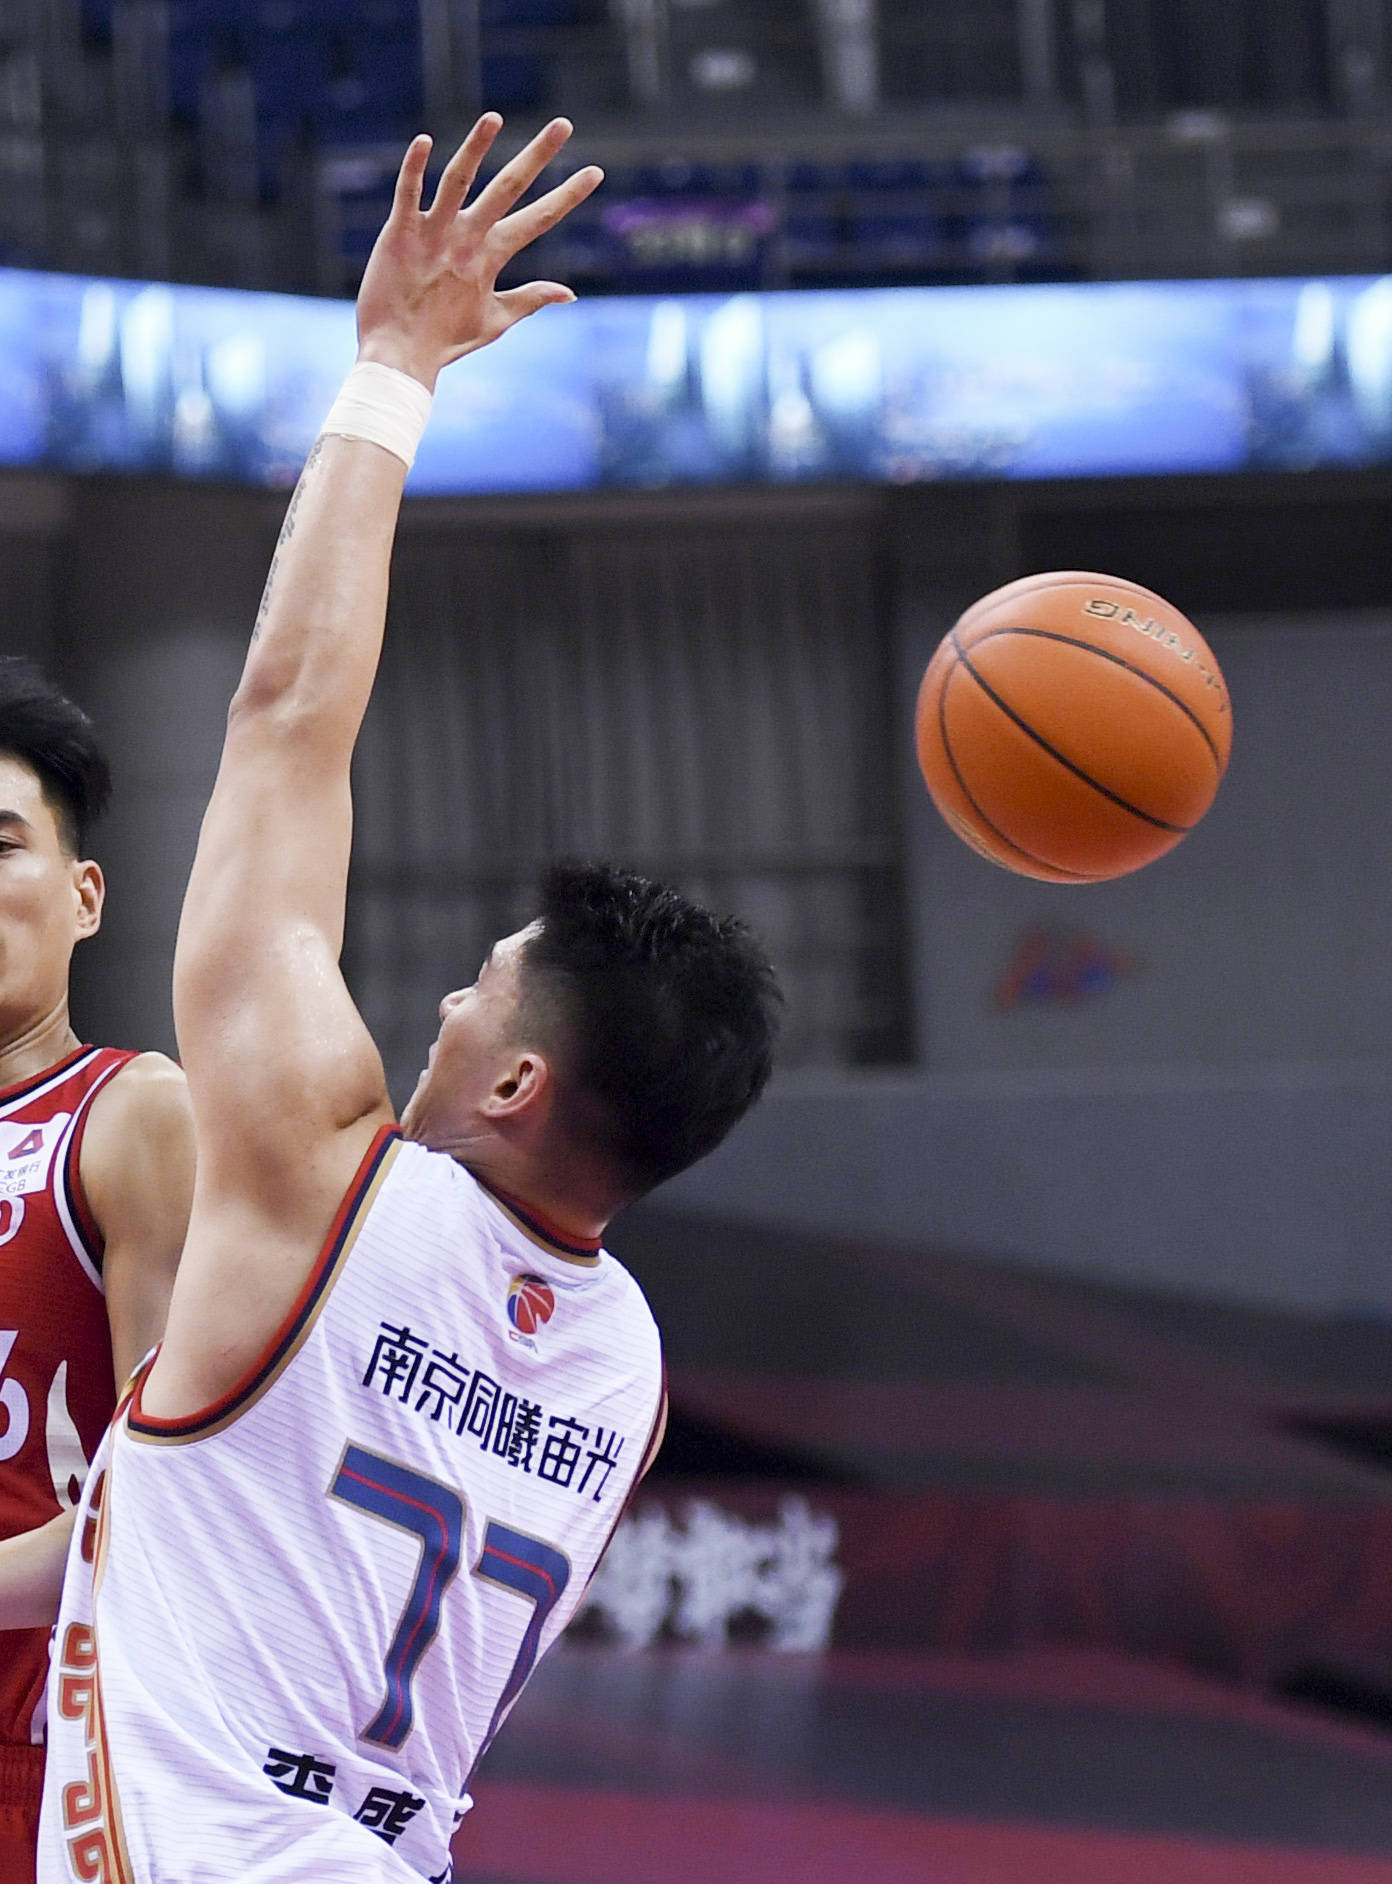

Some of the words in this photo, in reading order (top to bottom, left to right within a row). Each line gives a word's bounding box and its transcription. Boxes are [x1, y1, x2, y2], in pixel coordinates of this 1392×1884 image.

[362, 1321, 625, 1502] 南京同曦宙光
[326, 1438, 573, 1770] 77
